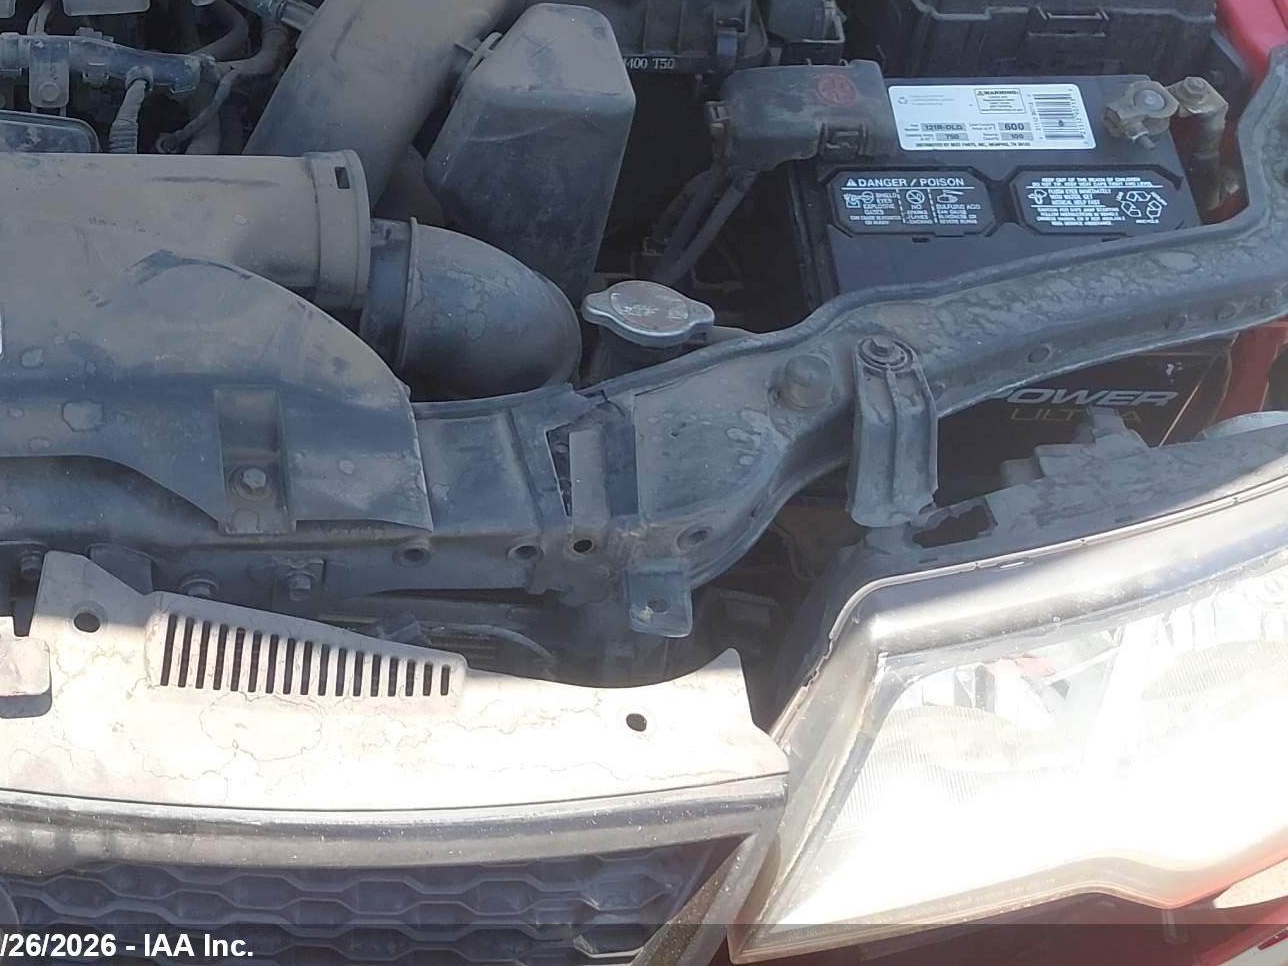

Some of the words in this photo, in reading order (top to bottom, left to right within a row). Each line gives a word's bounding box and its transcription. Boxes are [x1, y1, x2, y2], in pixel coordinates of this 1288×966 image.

[1004, 122, 1025, 131] 600
[857, 178, 908, 187] DANGER
[920, 177, 965, 187] POISON
[1010, 407, 1143, 422] ULTA
